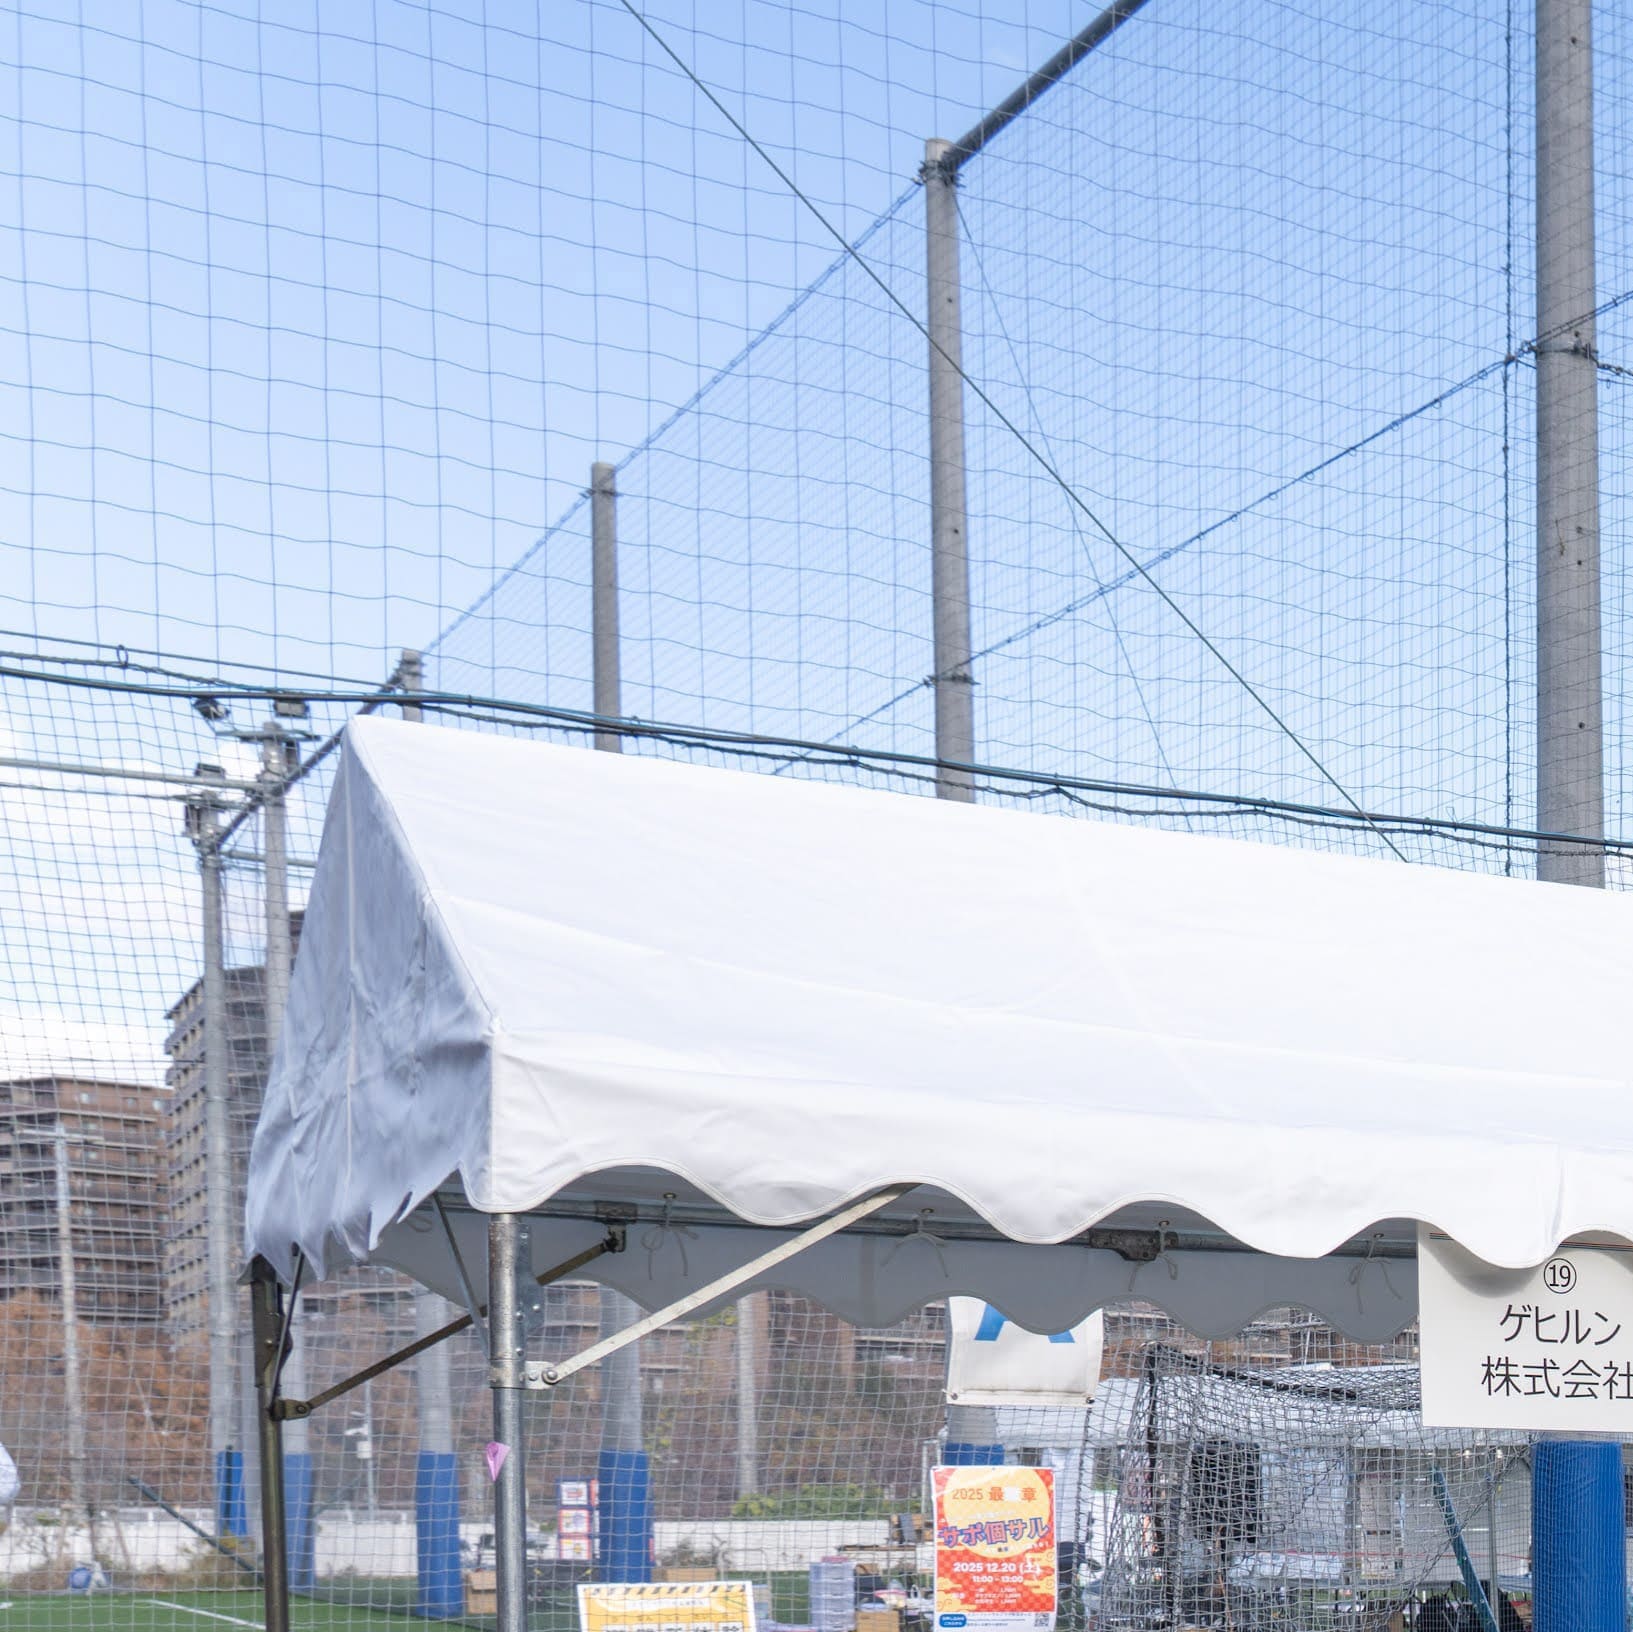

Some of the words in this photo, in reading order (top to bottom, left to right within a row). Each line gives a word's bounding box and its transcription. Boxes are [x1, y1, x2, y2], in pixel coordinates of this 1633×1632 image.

[1499, 1303, 1622, 1346] ゲヒルン
[988, 1487, 1037, 1502] 最章
[939, 1517, 1050, 1548] サポ個サル
[953, 1562, 983, 1572] 2025
